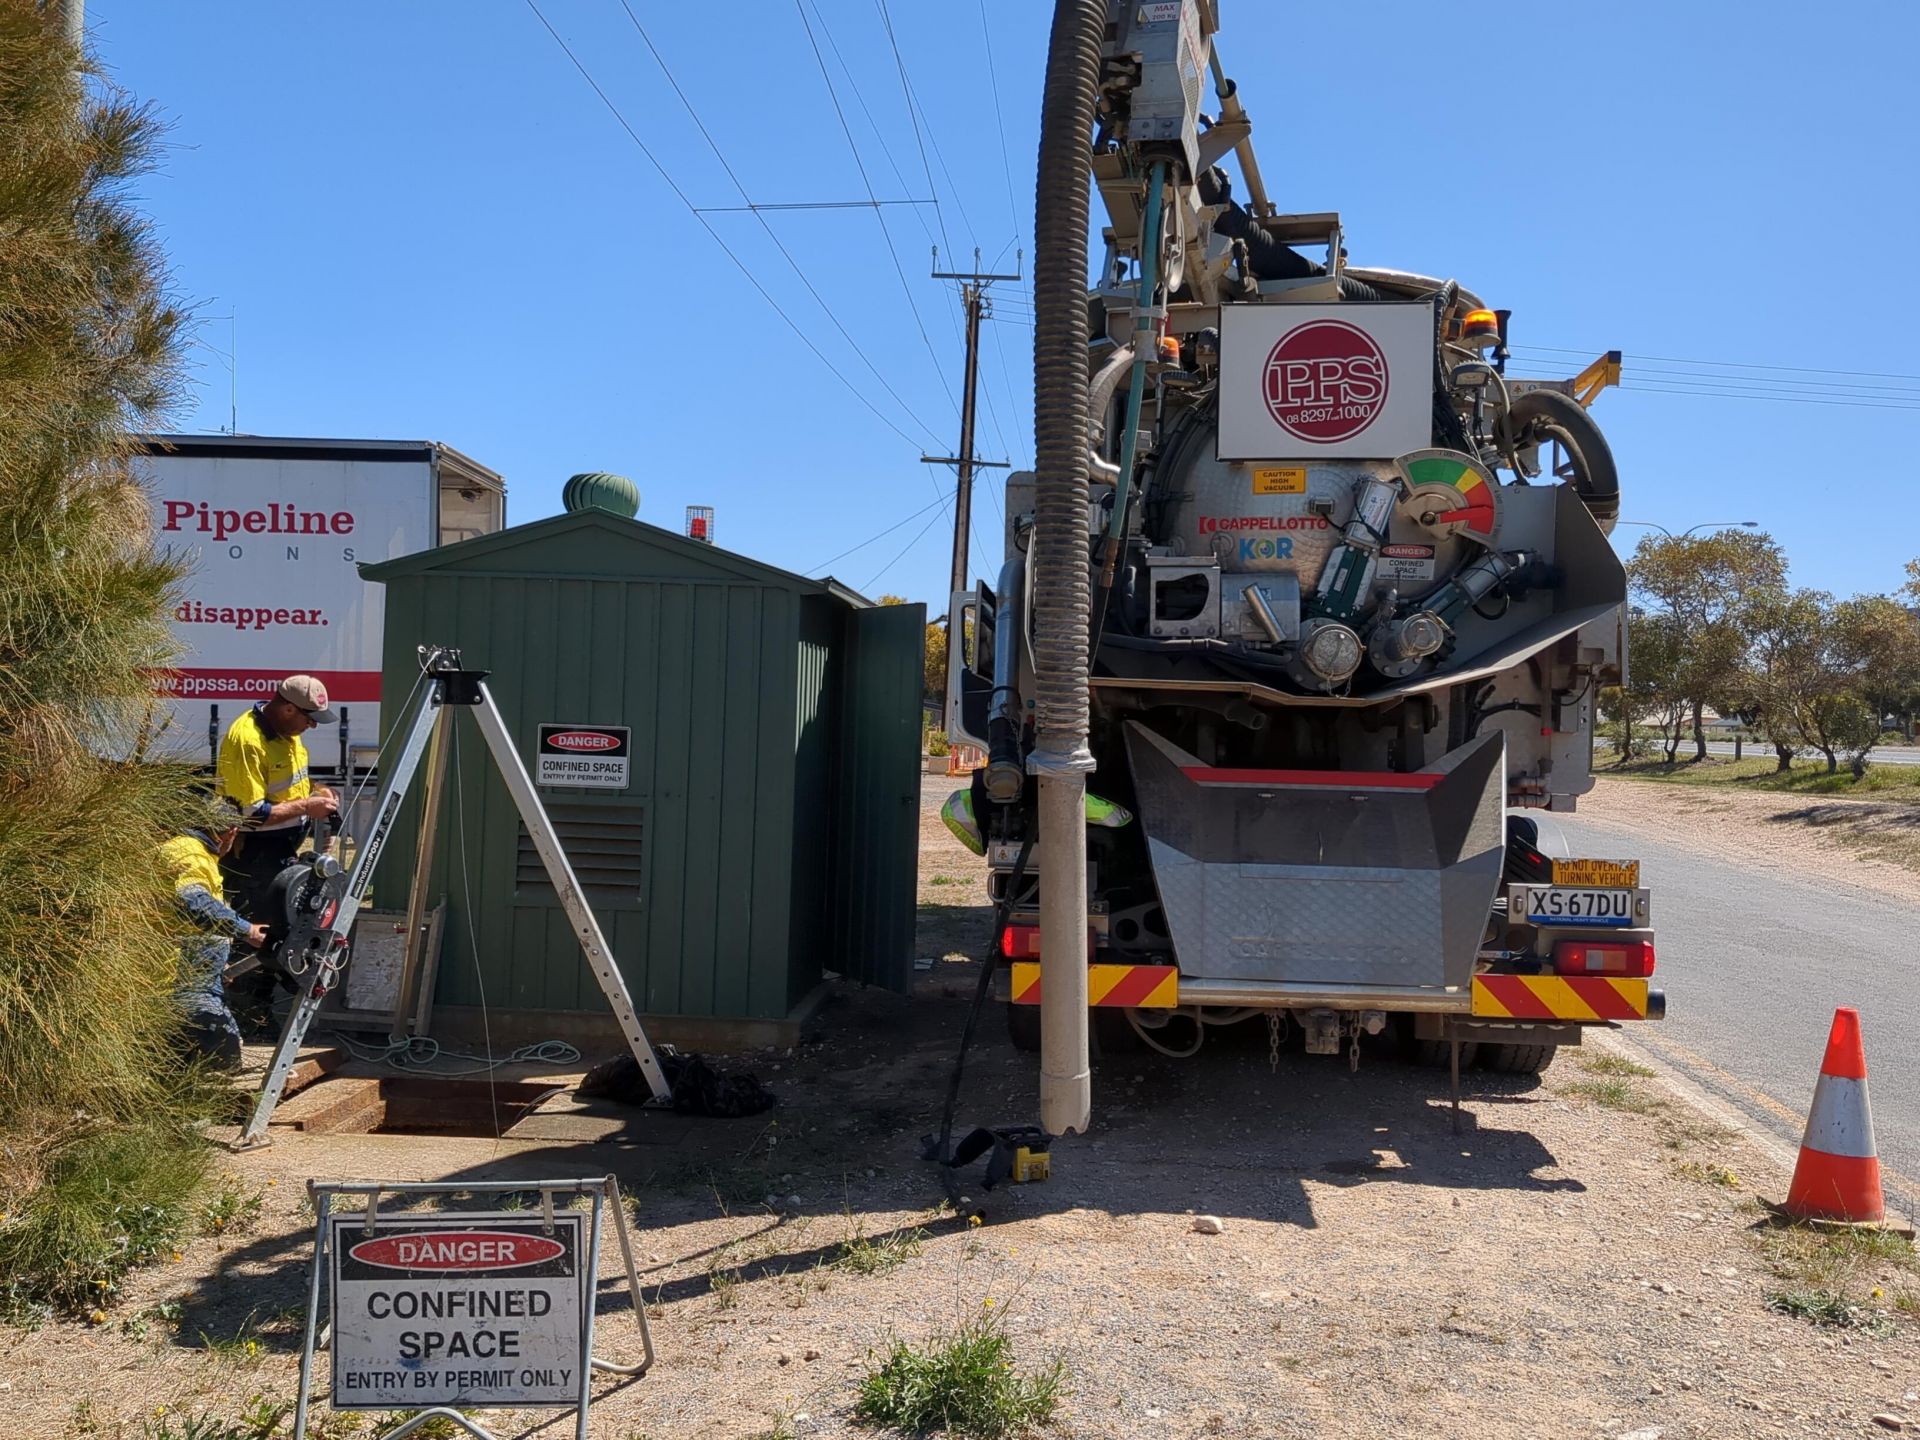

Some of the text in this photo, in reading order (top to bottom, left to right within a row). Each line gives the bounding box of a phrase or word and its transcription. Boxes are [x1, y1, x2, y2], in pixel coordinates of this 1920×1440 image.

[1154, 4, 1175, 12] MAX
[1269, 355, 1384, 408] PPS
[1286, 404, 1370, 424] 08 8297 1000
[162, 501, 354, 541] Pipeline
[1219, 515, 1328, 530] CAPPELLOTTO
[1239, 537, 1293, 560] KOR
[1388, 547, 1426, 555] DANGER
[175, 601, 328, 630] disappear.
[558, 735, 609, 747] DANGER
[542, 760, 624, 774] CONFINED SPACE
[566, 773, 576, 781] BY
[577, 774, 603, 782] PERMIT
[604, 775, 622, 783] ONLY
[1572, 861, 1588, 871] NOT
[1560, 872, 1595, 884] TURNING
[399, 1240, 516, 1264] DANGER
[367, 1289, 551, 1319] CONFINED
[400, 1330, 520, 1359] SPACE
[346, 1368, 572, 1389] ENTRY BY PERMIT ONLY
